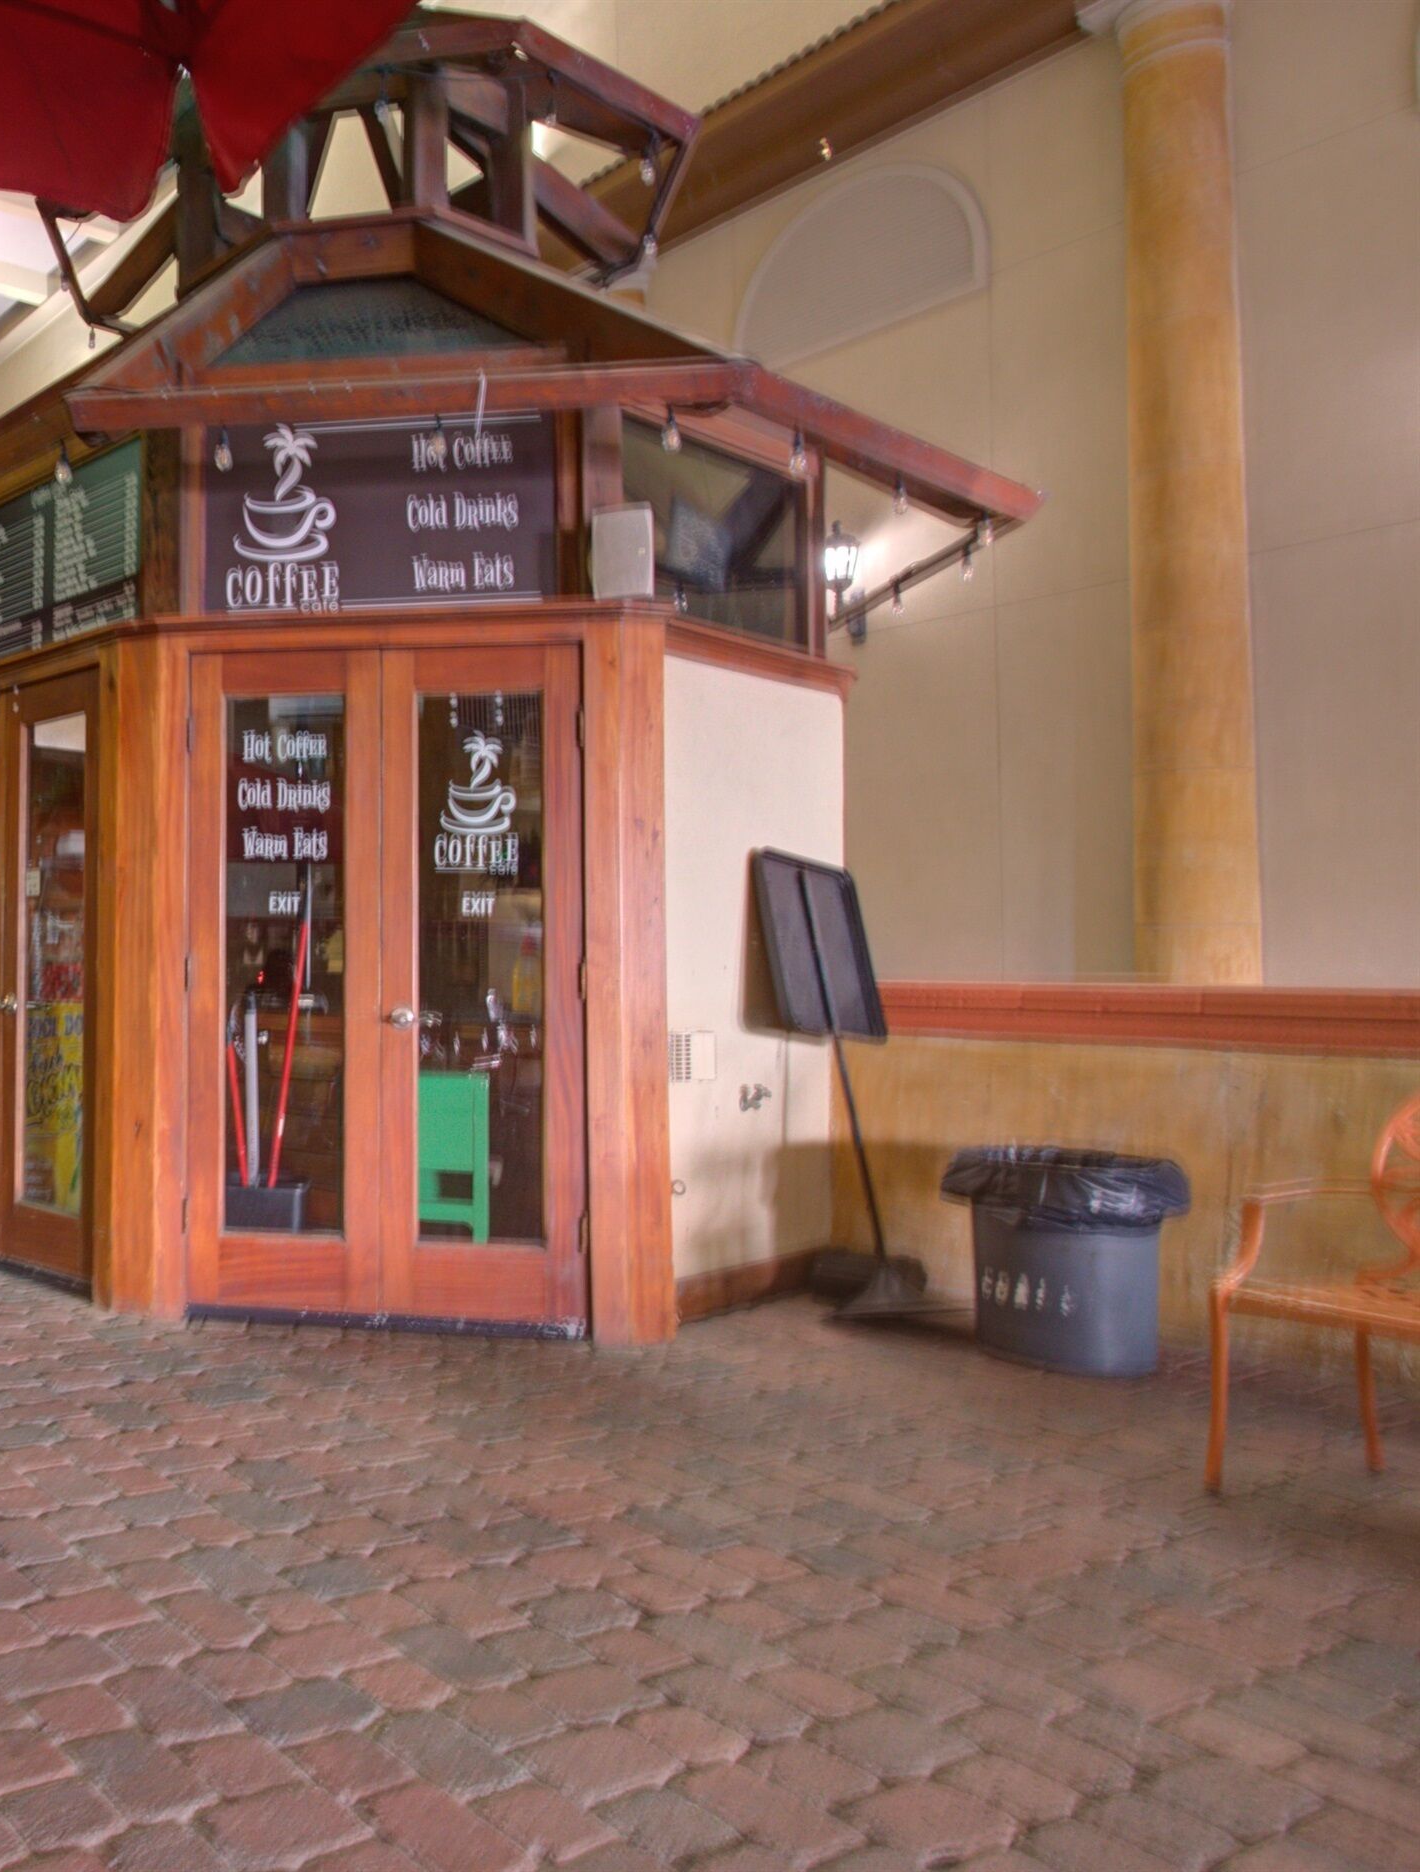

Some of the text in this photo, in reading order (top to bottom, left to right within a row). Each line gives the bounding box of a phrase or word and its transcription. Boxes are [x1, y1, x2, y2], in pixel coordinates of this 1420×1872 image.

[407, 491, 519, 532] Cold Drinks
[412, 551, 515, 593] Warm Eats
[242, 729, 328, 763] Hot Coffee
[237, 778, 331, 814] Cold Drinks
[242, 826, 329, 861] Warm Eats
[268, 892, 302, 916] EXIT
[461, 891, 496, 918] EXIT
